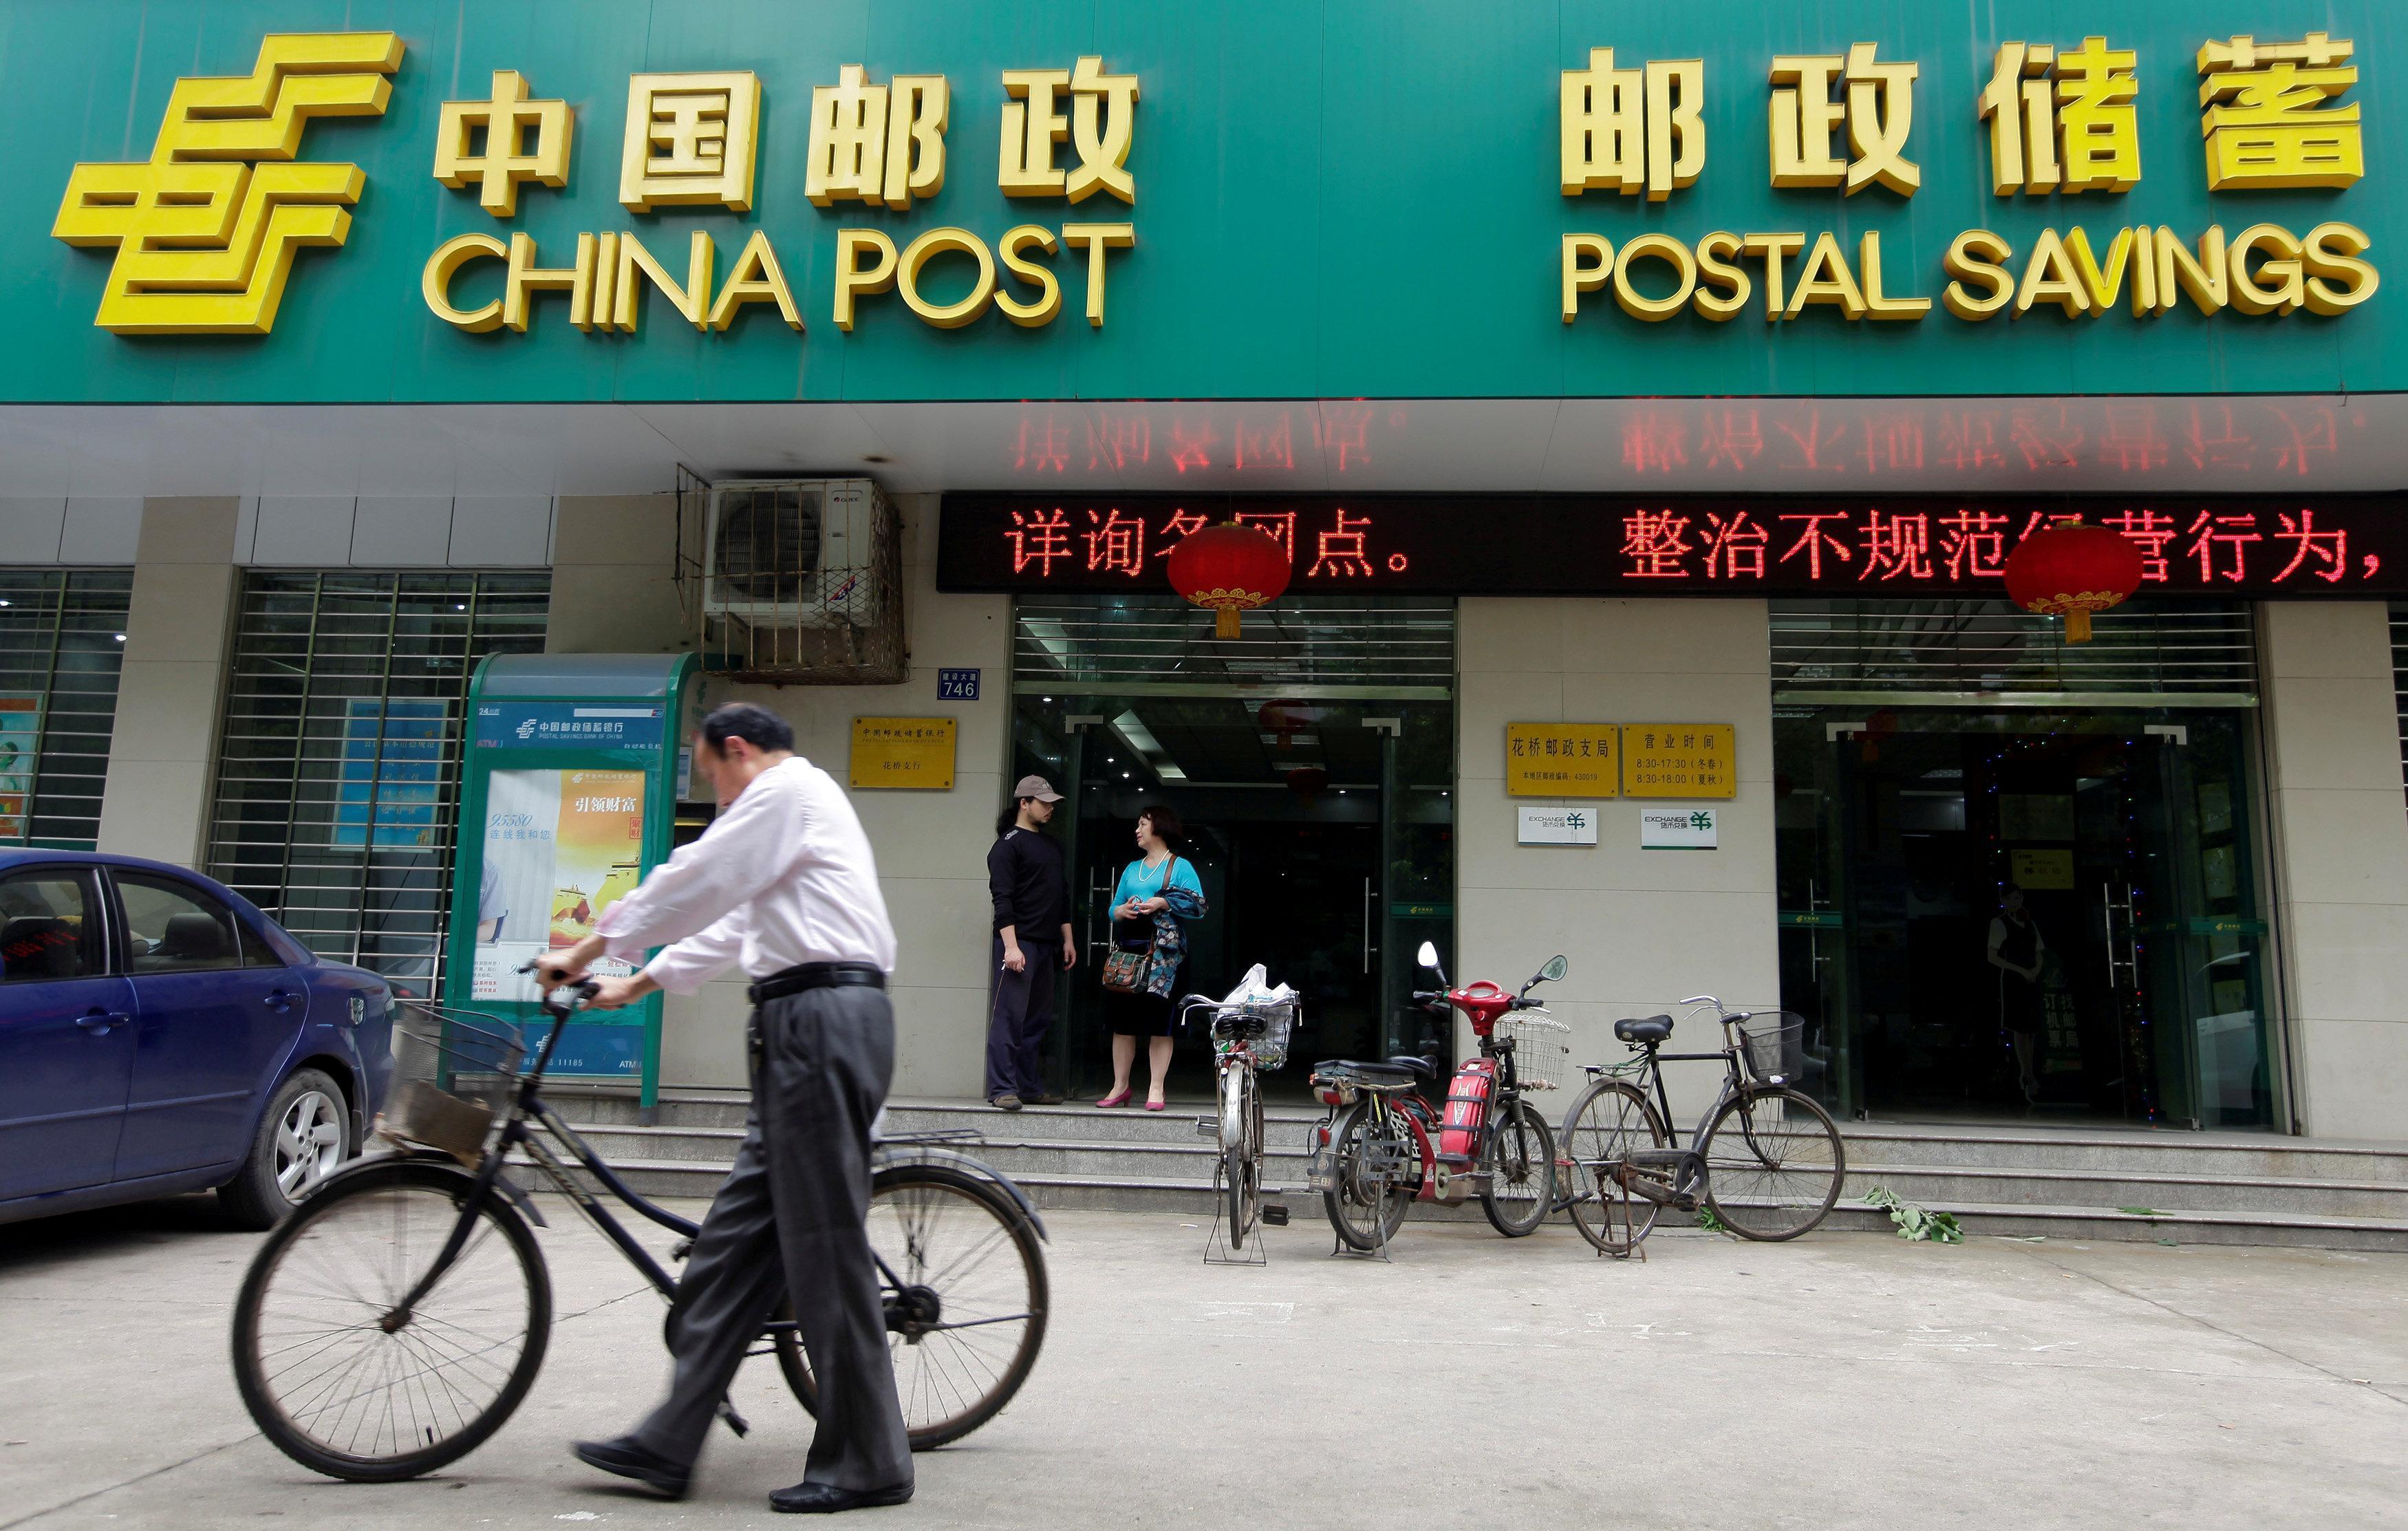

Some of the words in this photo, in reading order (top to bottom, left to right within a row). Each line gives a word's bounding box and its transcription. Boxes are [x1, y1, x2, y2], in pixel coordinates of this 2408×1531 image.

[1560, 32, 2364, 202] 邮政储蓄
[433, 56, 1140, 217] 中国邮政
[422, 230, 806, 334] CHINA
[832, 222, 1136, 332] POST
[1561, 231, 1932, 324] POSTAL
[1942, 222, 2380, 322] SAVINGS
[943, 672, 976, 681] 建设大道
[944, 682, 974, 696] 746
[540, 722, 623, 732] 中国邮政储蓄银行
[863, 727, 945, 738] 中国邮政储蓄银行
[477, 739, 497, 748] ATM
[1512, 737, 1609, 758] 花桥邮政支局
[1645, 734, 1714, 749] 营业时间
[883, 760, 922, 771] 花桥支行
[576, 797, 637, 813] 引领财富
[486, 813, 533, 828] 95580
[490, 828, 550, 840] 连线我和您
